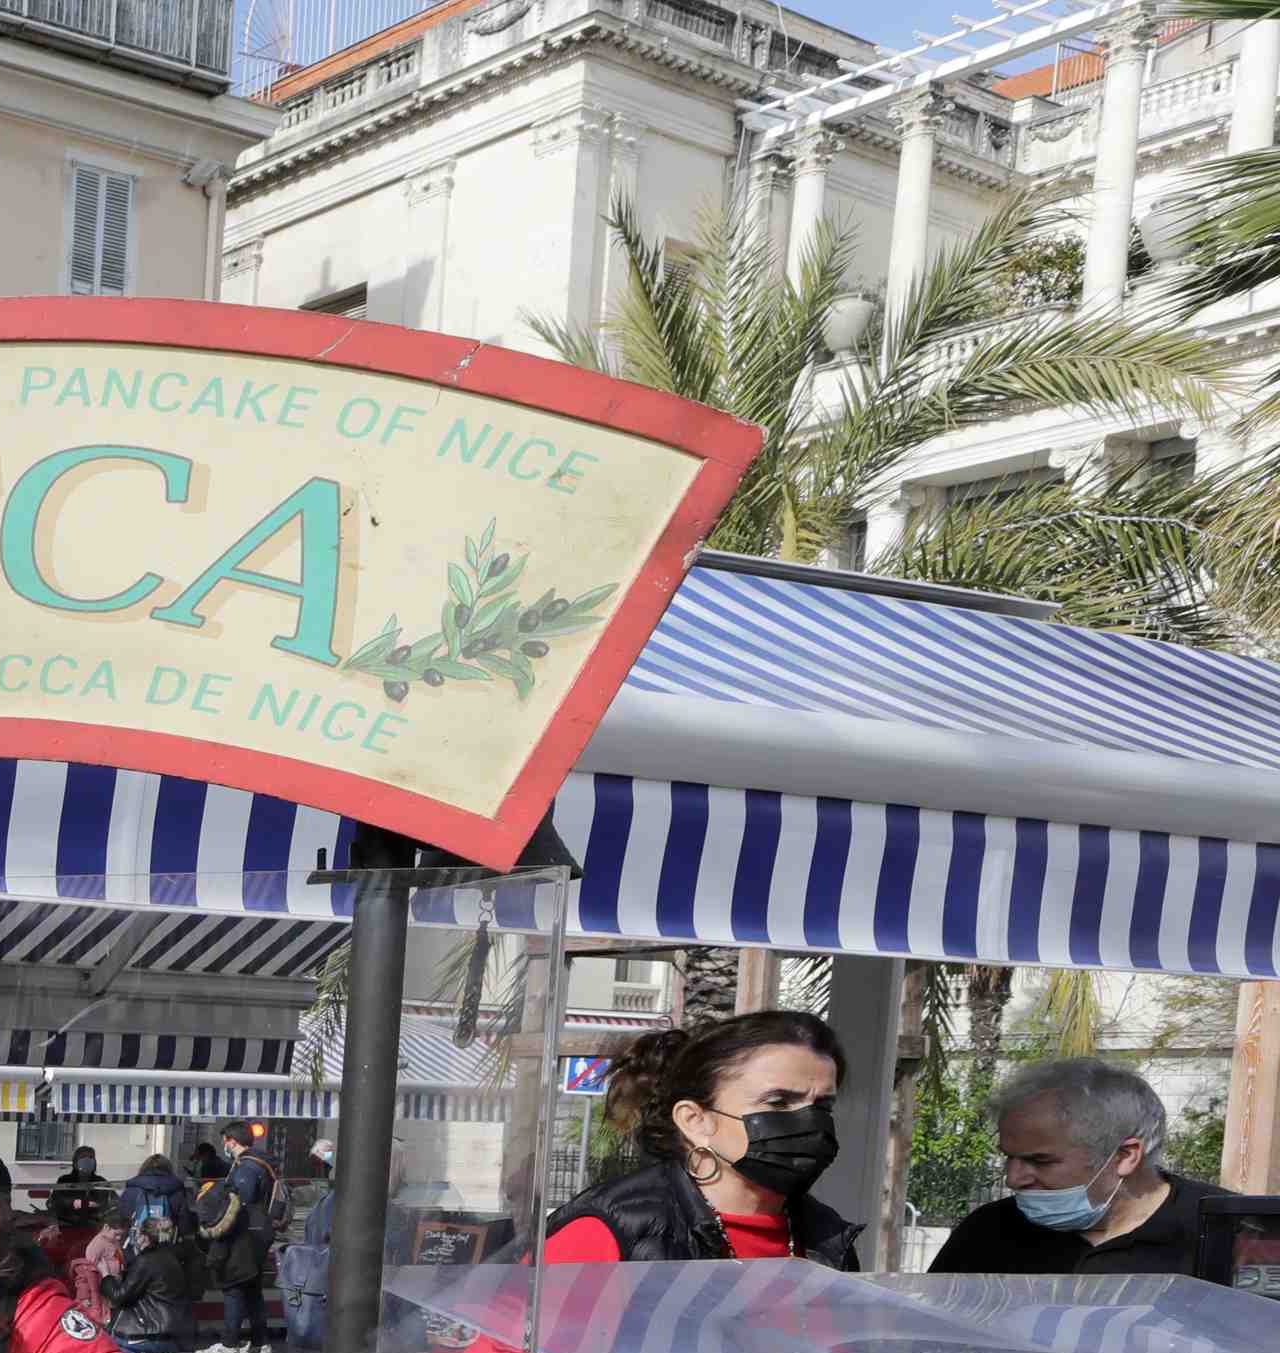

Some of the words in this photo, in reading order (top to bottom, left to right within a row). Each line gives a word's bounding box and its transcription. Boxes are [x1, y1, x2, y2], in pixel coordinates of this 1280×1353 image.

[18, 366, 319, 429] PANCAKE
[335, 397, 426, 446] OF
[437, 417, 601, 495] NICE
[144, 666, 232, 715] DE
[248, 682, 409, 755] NICE
